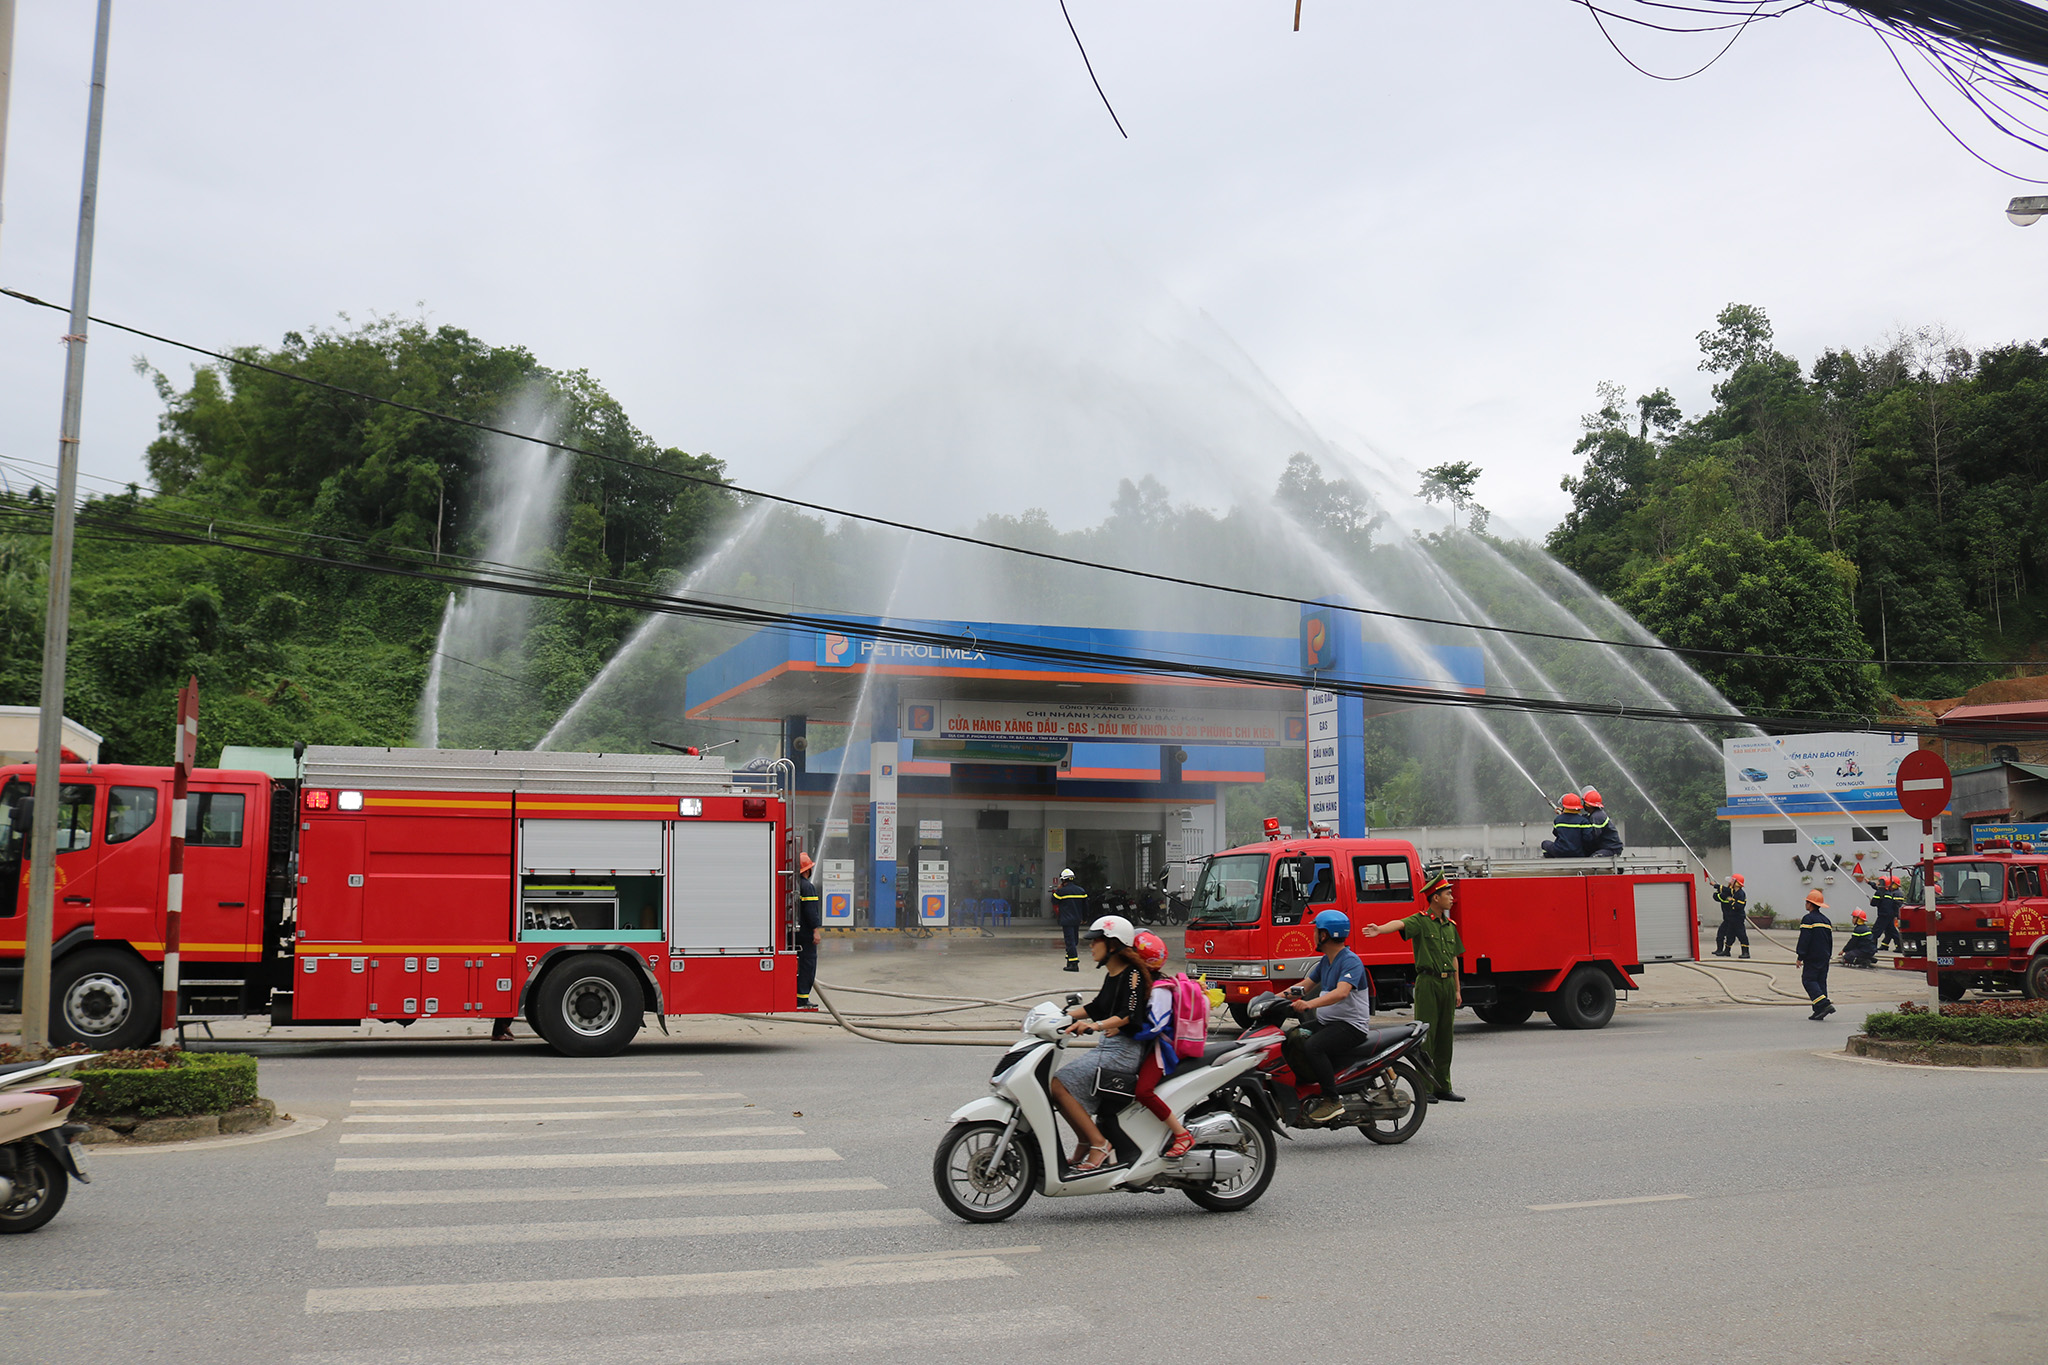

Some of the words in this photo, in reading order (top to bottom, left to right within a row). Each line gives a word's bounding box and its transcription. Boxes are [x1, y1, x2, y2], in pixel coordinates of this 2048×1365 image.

[861, 641, 986, 661] PETROLIMEX
[948, 714, 969, 731] CỬA
[973, 717, 1001, 732] HÀNG
[1005, 718, 1033, 732] XĂNG
[1038, 718, 1057, 733] DẦU
[1068, 722, 1088, 734] GAS
[1098, 719, 1118, 734] DẦU
[1121, 722, 1138, 736] MỠ
[1140, 723, 1167, 736] NHỜN
[1170, 722, 1183, 736] SỐ
[1200, 725, 1232, 738] PHÙNG
[1319, 721, 1328, 731] GAS
[1820, 750, 1835, 758] BẢO
[1837, 748, 1854, 757] HIỂM
